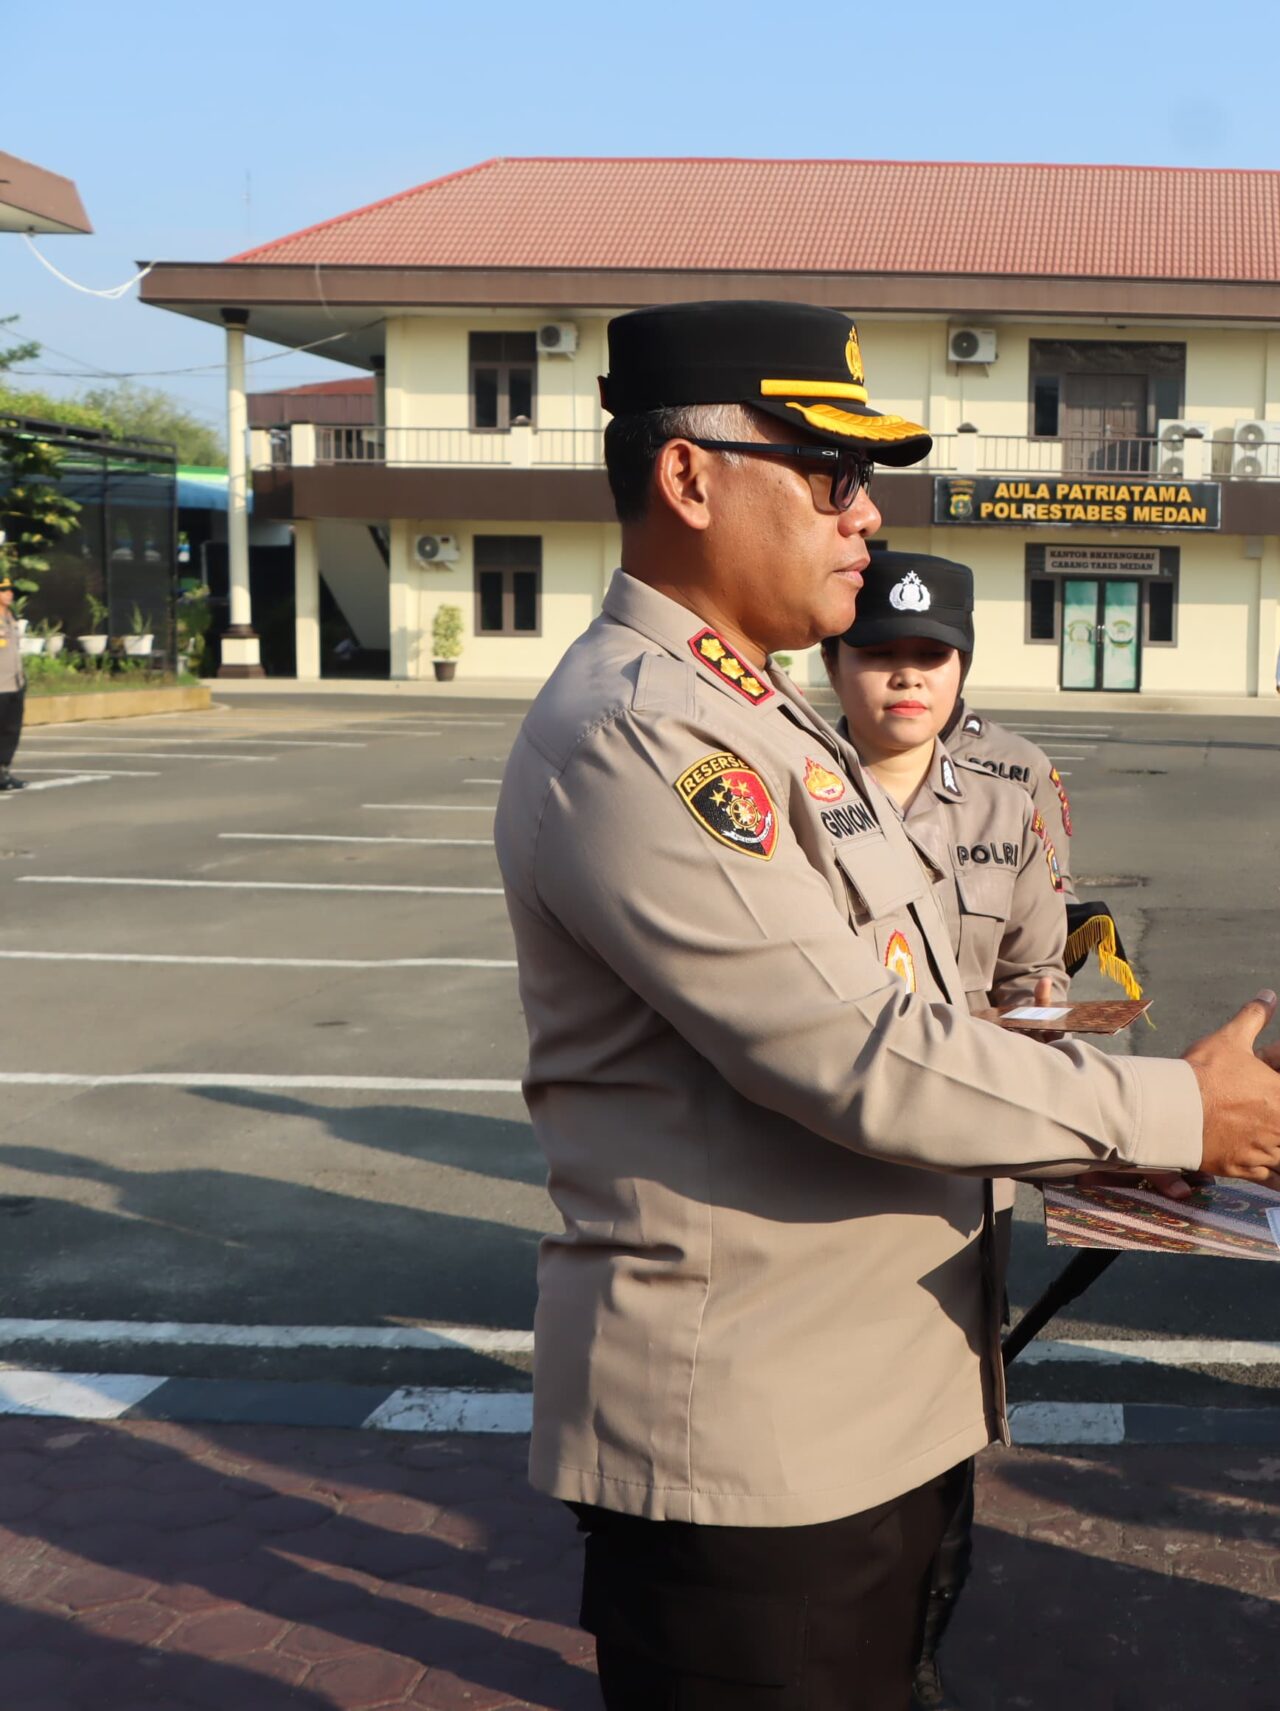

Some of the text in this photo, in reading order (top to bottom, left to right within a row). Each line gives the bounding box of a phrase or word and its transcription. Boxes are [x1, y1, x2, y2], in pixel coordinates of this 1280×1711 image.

[995, 483, 1192, 503] AULA PATRIATAMA
[980, 502, 1207, 523] POLRESTABES MEDAN
[1050, 550, 1155, 560] KANTOR BHAYANGKARI
[1051, 561, 1153, 571] CABANG TABES MEDAN
[820, 802, 876, 839] GIDION
[957, 843, 1019, 867] POLRI
